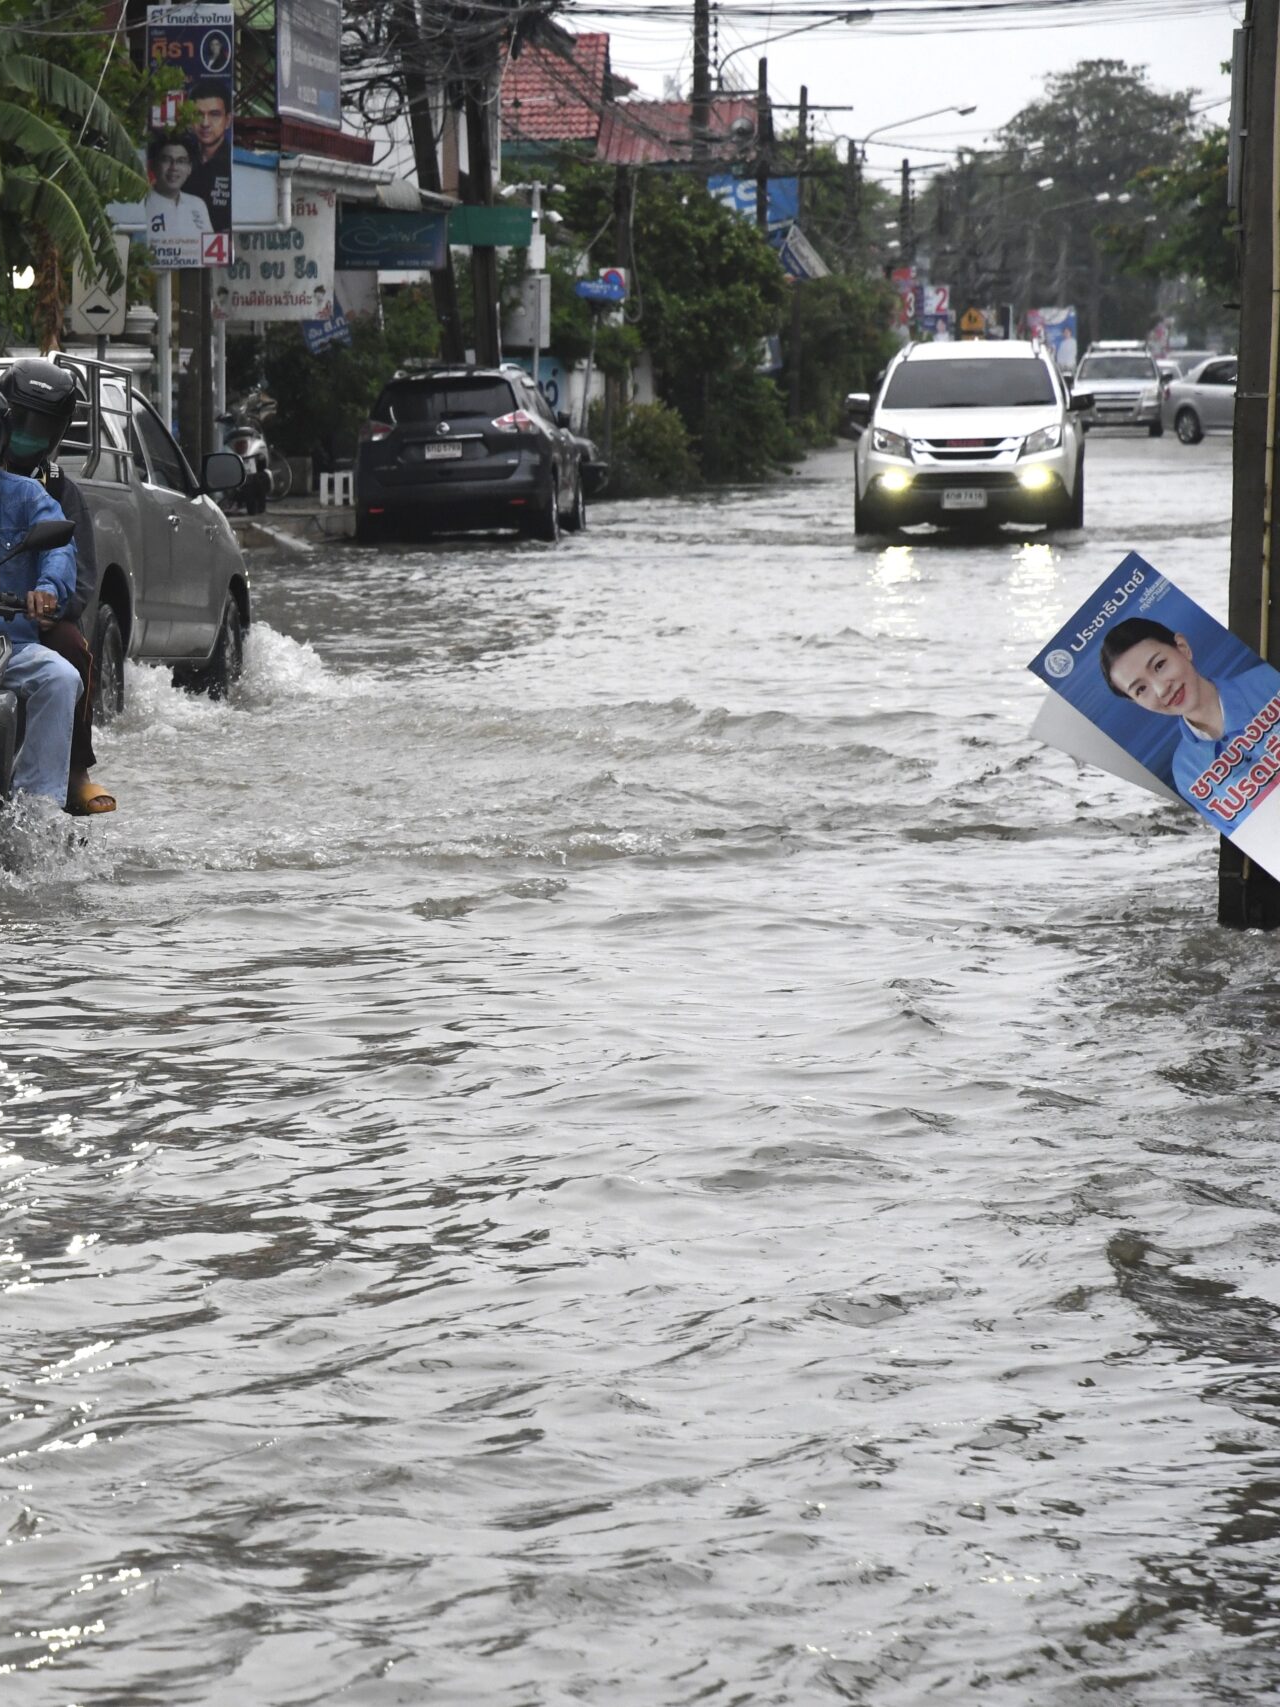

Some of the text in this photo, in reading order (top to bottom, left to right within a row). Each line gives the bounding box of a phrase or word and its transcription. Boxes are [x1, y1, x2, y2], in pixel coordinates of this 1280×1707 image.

[204, 233, 227, 262] 4
[260, 261, 285, 279] อบ
[935, 287, 948, 313] 2
[1070, 568, 1145, 652] ประชาธิปัตย์
[1190, 691, 1280, 799] ชาวบางเข
